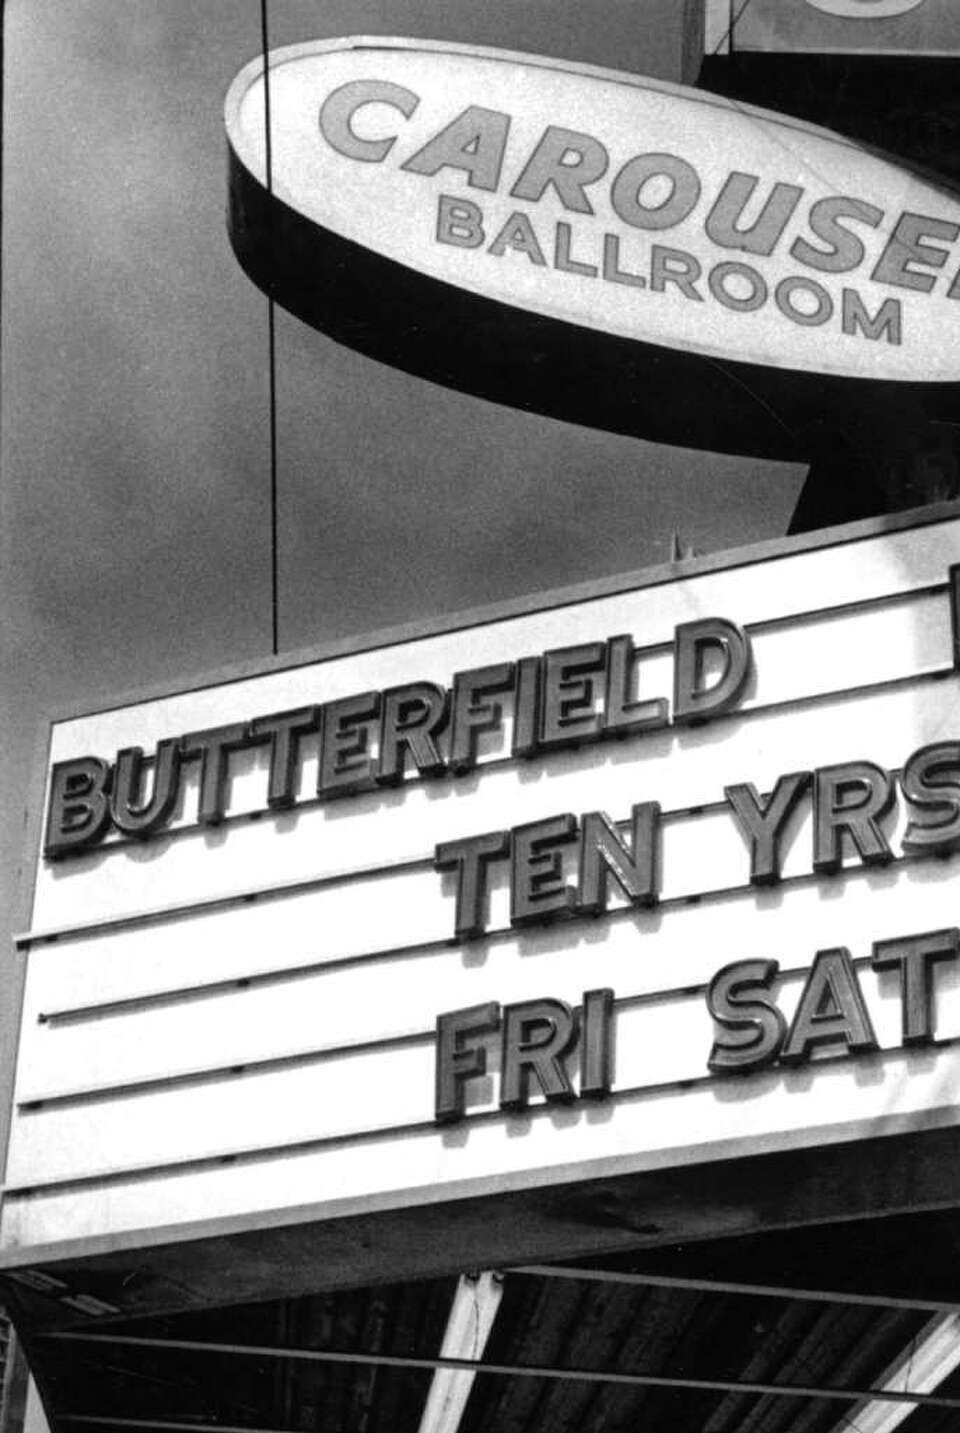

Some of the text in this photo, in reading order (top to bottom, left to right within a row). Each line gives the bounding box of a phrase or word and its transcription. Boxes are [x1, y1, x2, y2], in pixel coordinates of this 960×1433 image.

[435, 194, 903, 346] BALLROOM
[44, 616, 752, 859] BUTTERFIELD
[435, 800, 661, 941] TEN
[435, 988, 614, 1123] FRI
